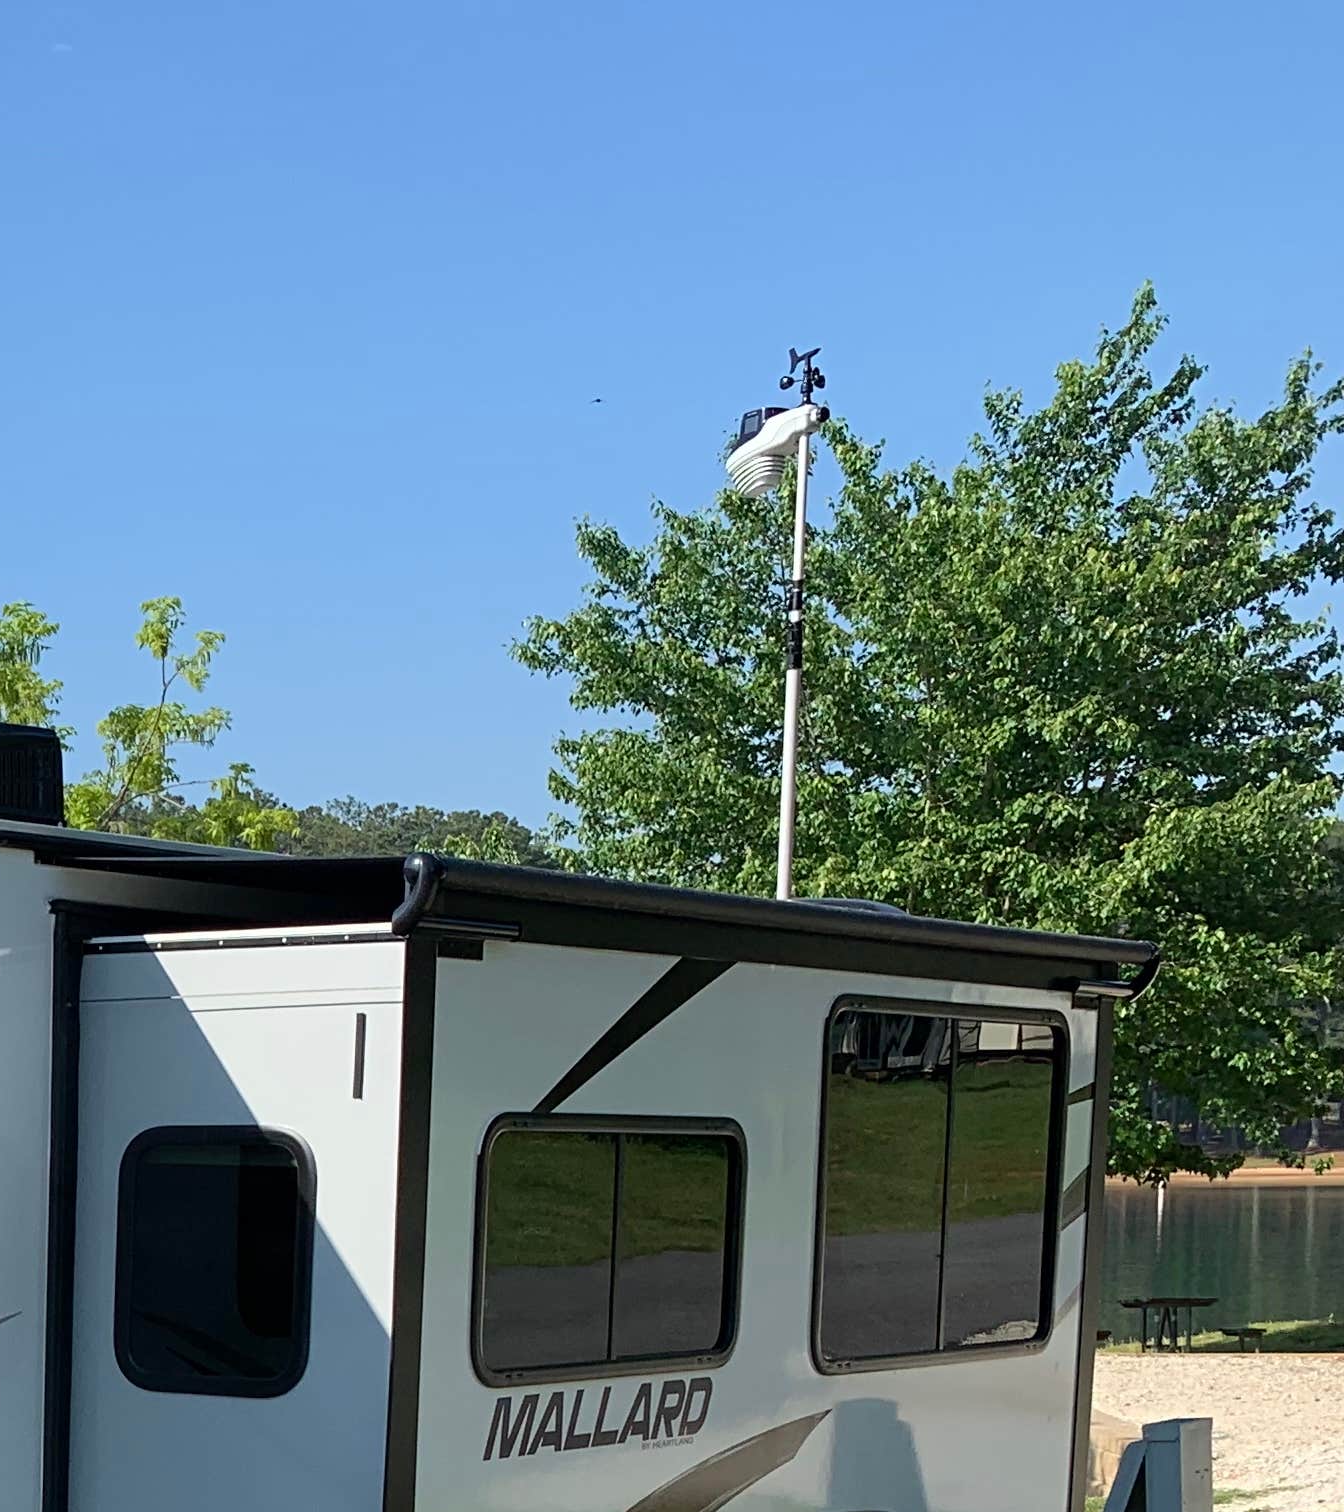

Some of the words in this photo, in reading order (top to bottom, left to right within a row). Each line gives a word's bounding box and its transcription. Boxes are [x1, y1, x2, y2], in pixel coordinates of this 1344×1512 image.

[482, 1376, 713, 1461] MALLARD
[641, 1442, 650, 1450] BY
[652, 1437, 694, 1449] HEARTLAND
